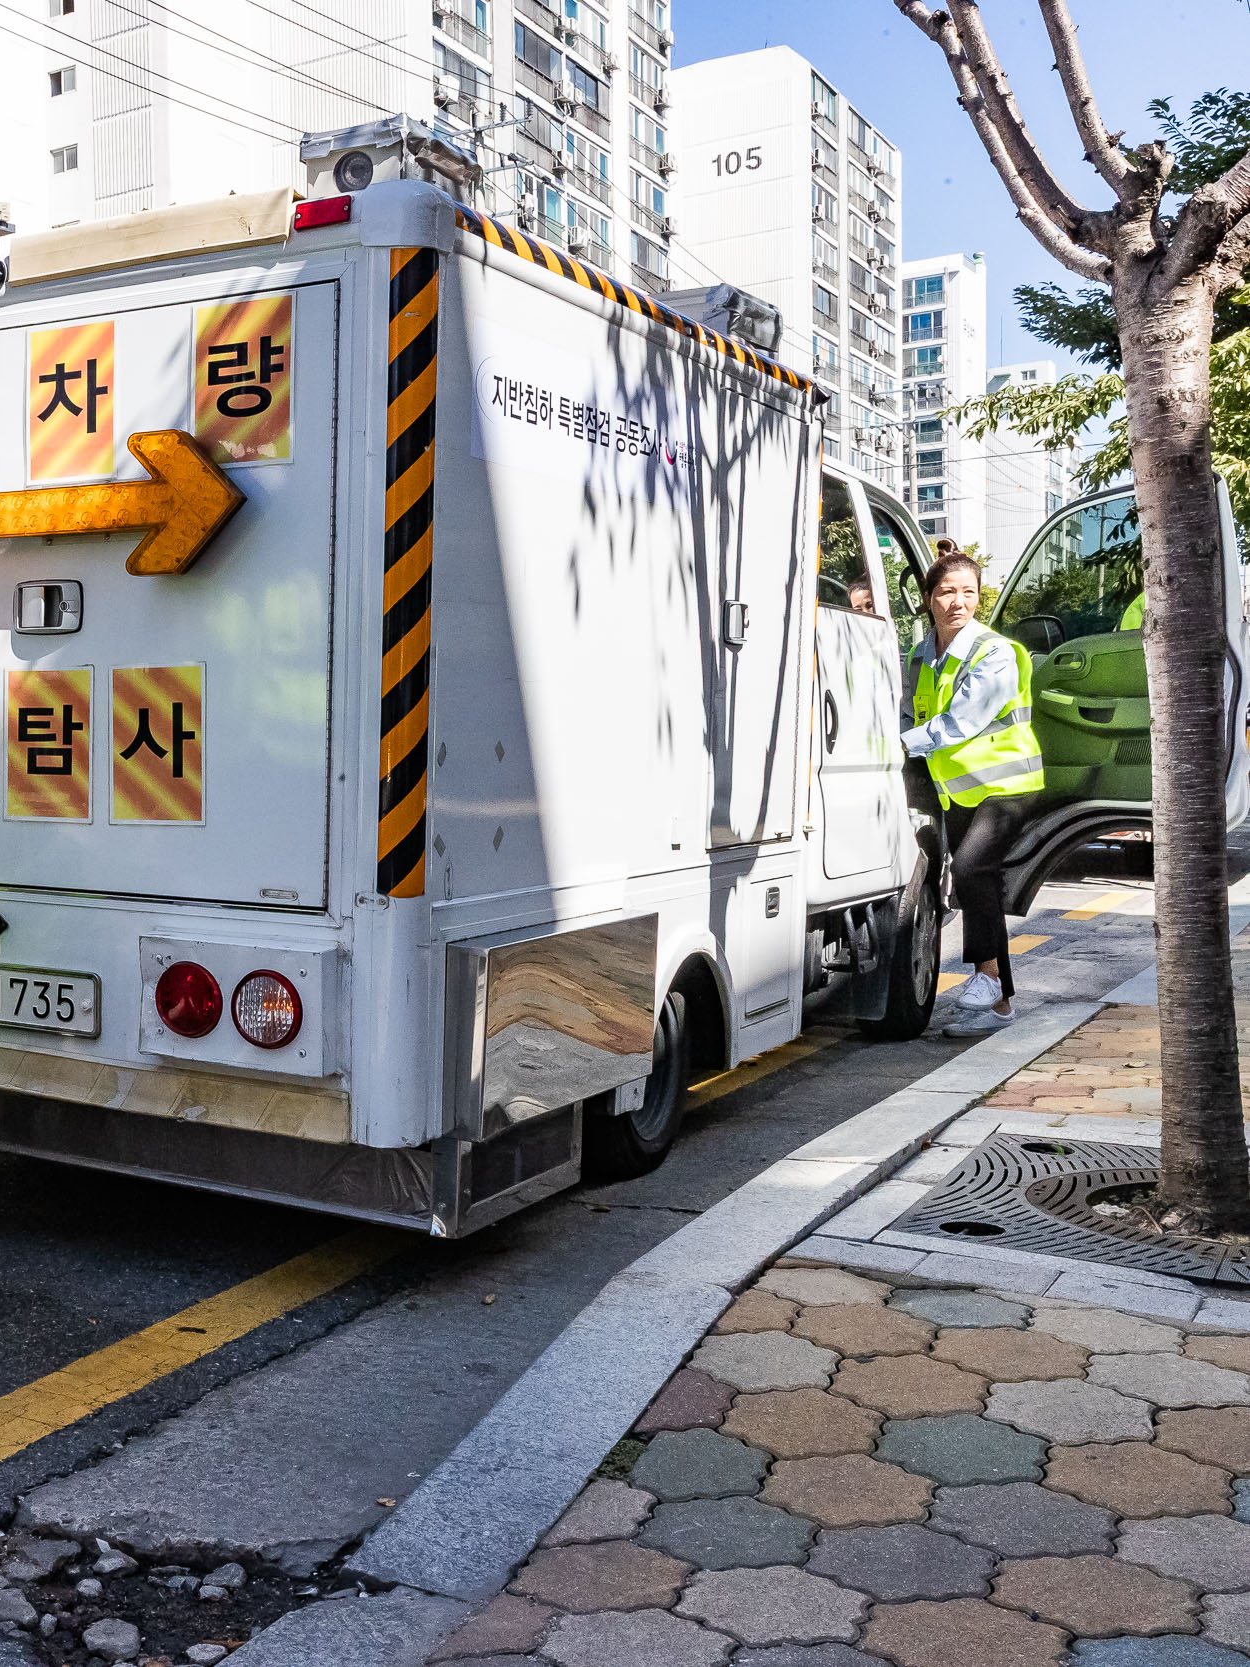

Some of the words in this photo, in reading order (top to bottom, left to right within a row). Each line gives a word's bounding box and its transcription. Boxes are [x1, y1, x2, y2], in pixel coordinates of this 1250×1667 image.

[711, 146, 763, 177] 105
[491, 374, 554, 430] 지반침하
[557, 396, 611, 449] 특별점검
[614, 415, 662, 464] 공동조사
